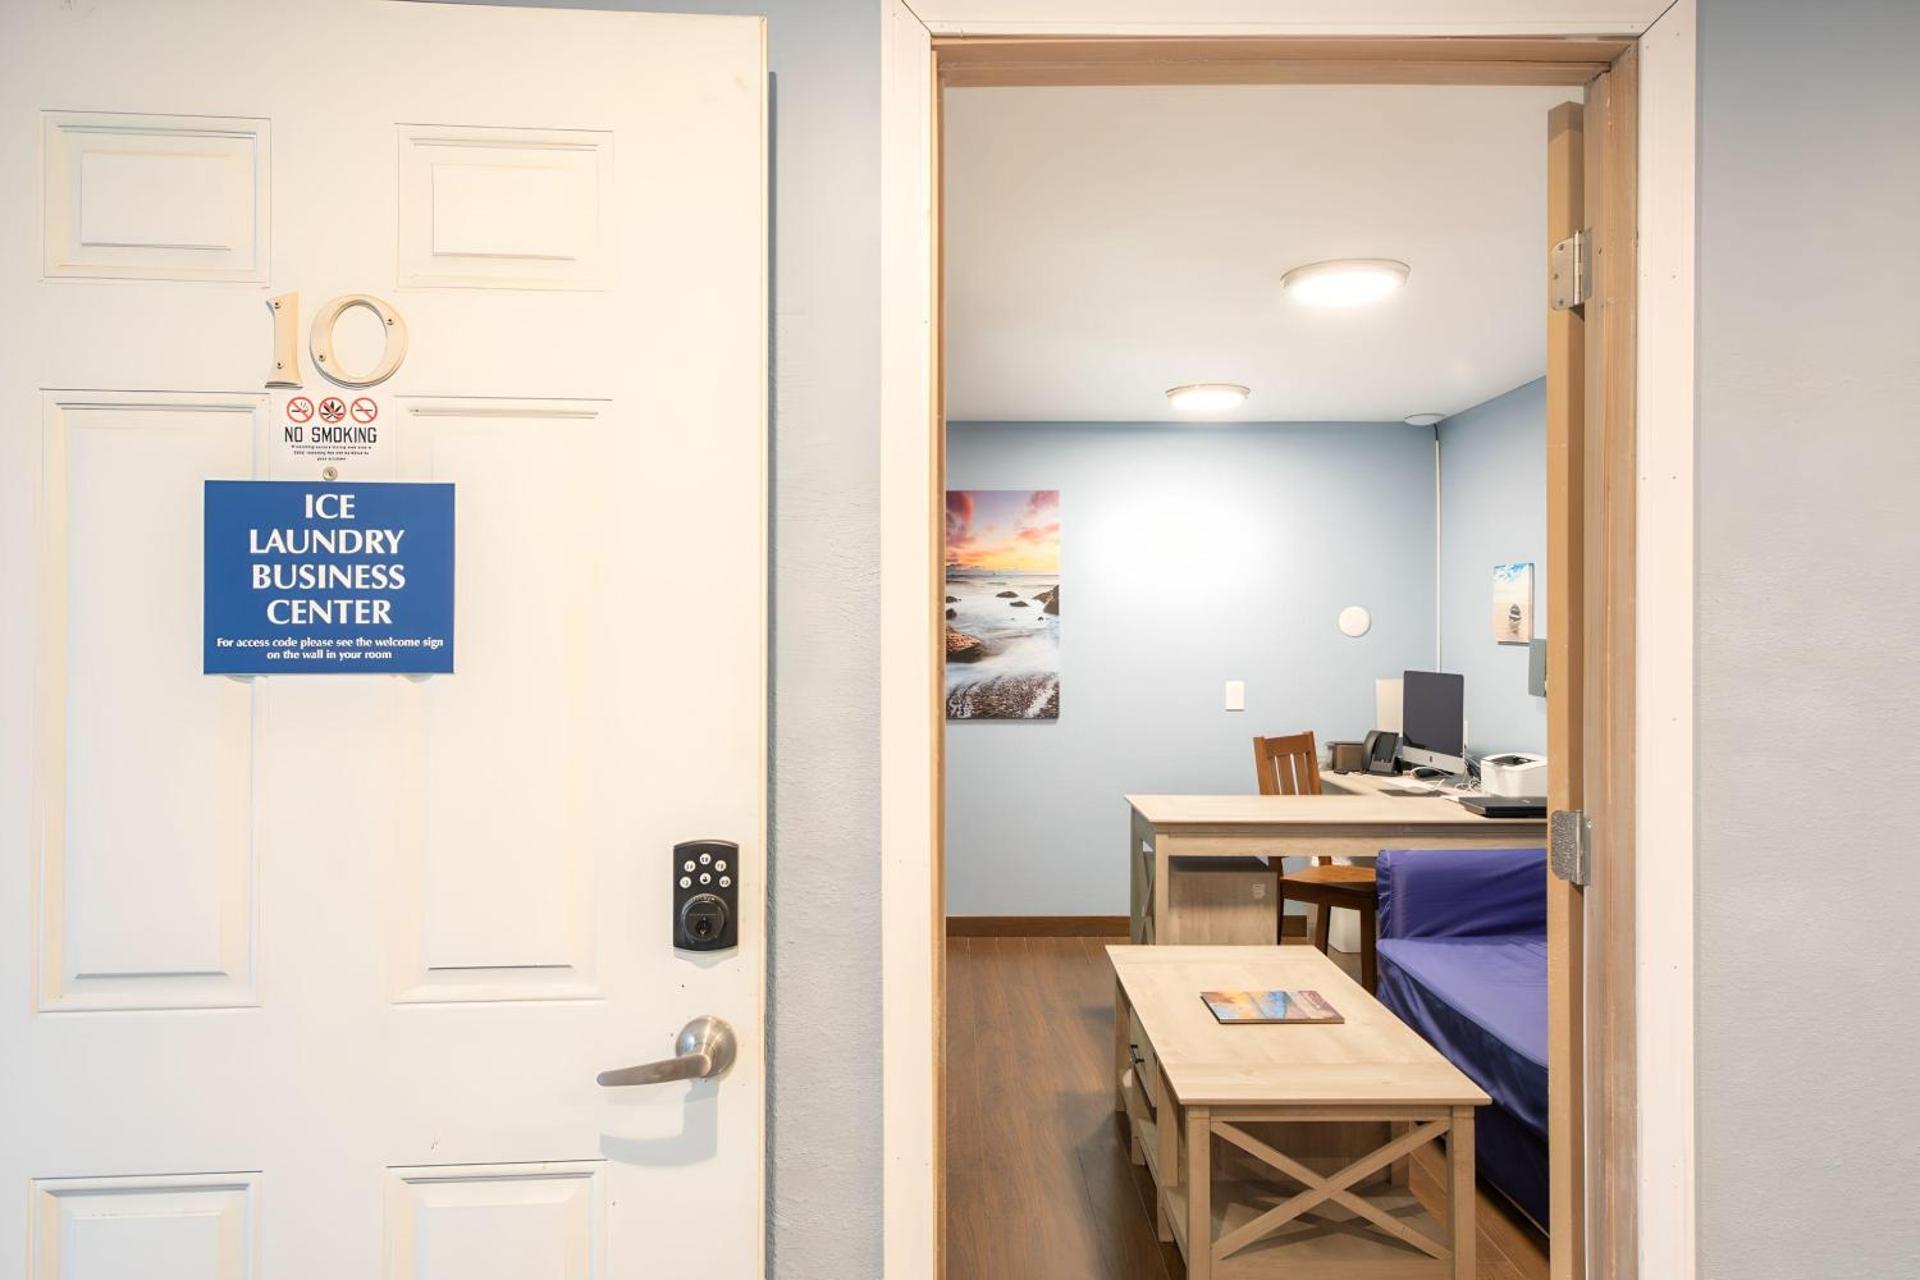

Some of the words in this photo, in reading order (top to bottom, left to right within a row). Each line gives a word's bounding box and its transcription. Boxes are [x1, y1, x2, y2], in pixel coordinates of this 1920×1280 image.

[285, 427, 303, 442] NO
[311, 427, 377, 444] SMOKING
[305, 494, 355, 519] ICE
[249, 529, 405, 554] LAUNDRY
[252, 564, 406, 589] BUSINESS
[266, 599, 392, 624] CENTER
[216, 637, 234, 647] For
[236, 639, 270, 648] access
[272, 637, 297, 648] code
[300, 637, 333, 650] please
[336, 639, 353, 648] see
[356, 637, 372, 648] the
[374, 637, 421, 648] welcome
[422, 637, 444, 650] sign
[266, 651, 280, 660] on
[283, 649, 300, 660] the
[302, 649, 323, 660] wall
[326, 649, 336, 660] in
[339, 651, 362, 662] your
[364, 651, 393, 660] room
